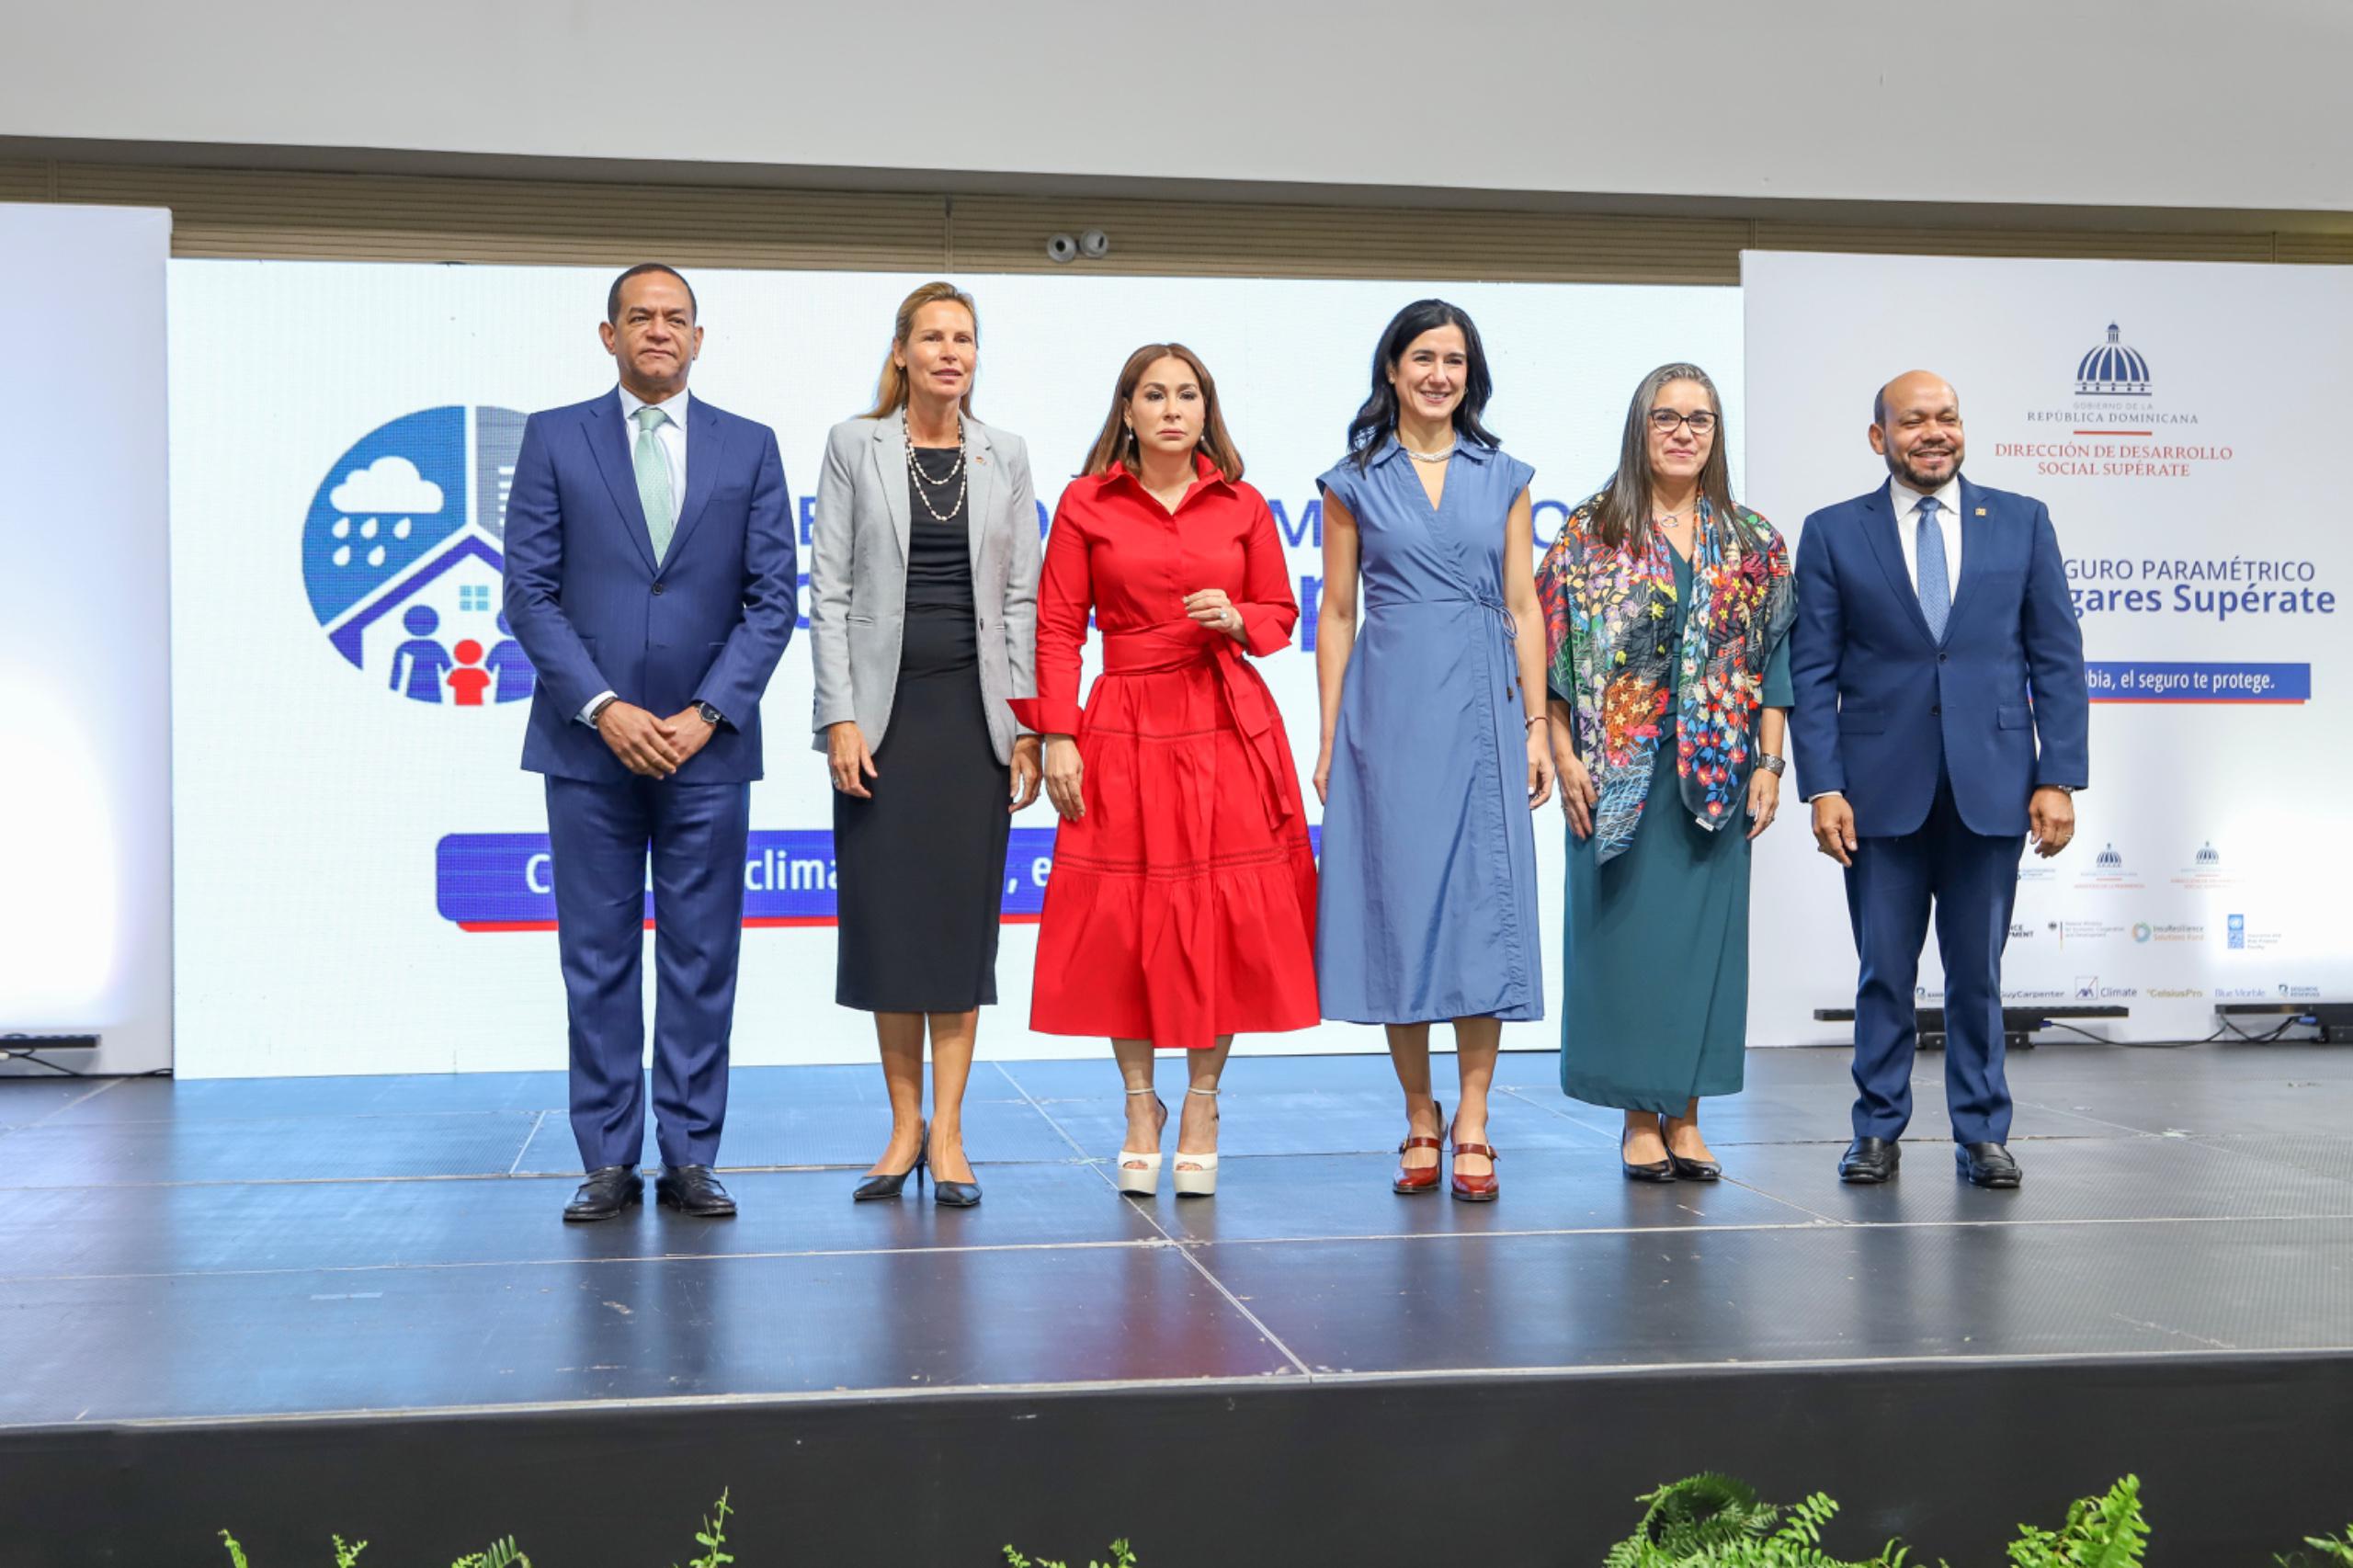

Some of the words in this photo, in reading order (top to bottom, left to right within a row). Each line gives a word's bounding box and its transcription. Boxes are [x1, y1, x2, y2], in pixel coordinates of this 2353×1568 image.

[2027, 411, 2104, 423] REPÚBLICA
[2109, 413, 2199, 425] DOMINICANA
[1995, 441, 2090, 458] DIRECCIÓN
[2094, 444, 2116, 459] DE
[2119, 445, 2234, 460] DESARROLLO
[2038, 461, 2099, 476] SOCIAL
[2103, 459, 2190, 477] SUPÉRATE
[2063, 559, 2133, 580] GURO
[2143, 555, 2316, 582] PARAMÉTRICO
[2070, 589, 2162, 618] gares
[2173, 582, 2336, 621] Supérate
[2086, 668, 2116, 691] bia,
[2120, 668, 2134, 688] el
[2139, 673, 2189, 694] seguro
[2193, 672, 2209, 689] te
[2212, 672, 2275, 694] protege.
[2100, 987, 2138, 998] Climate
